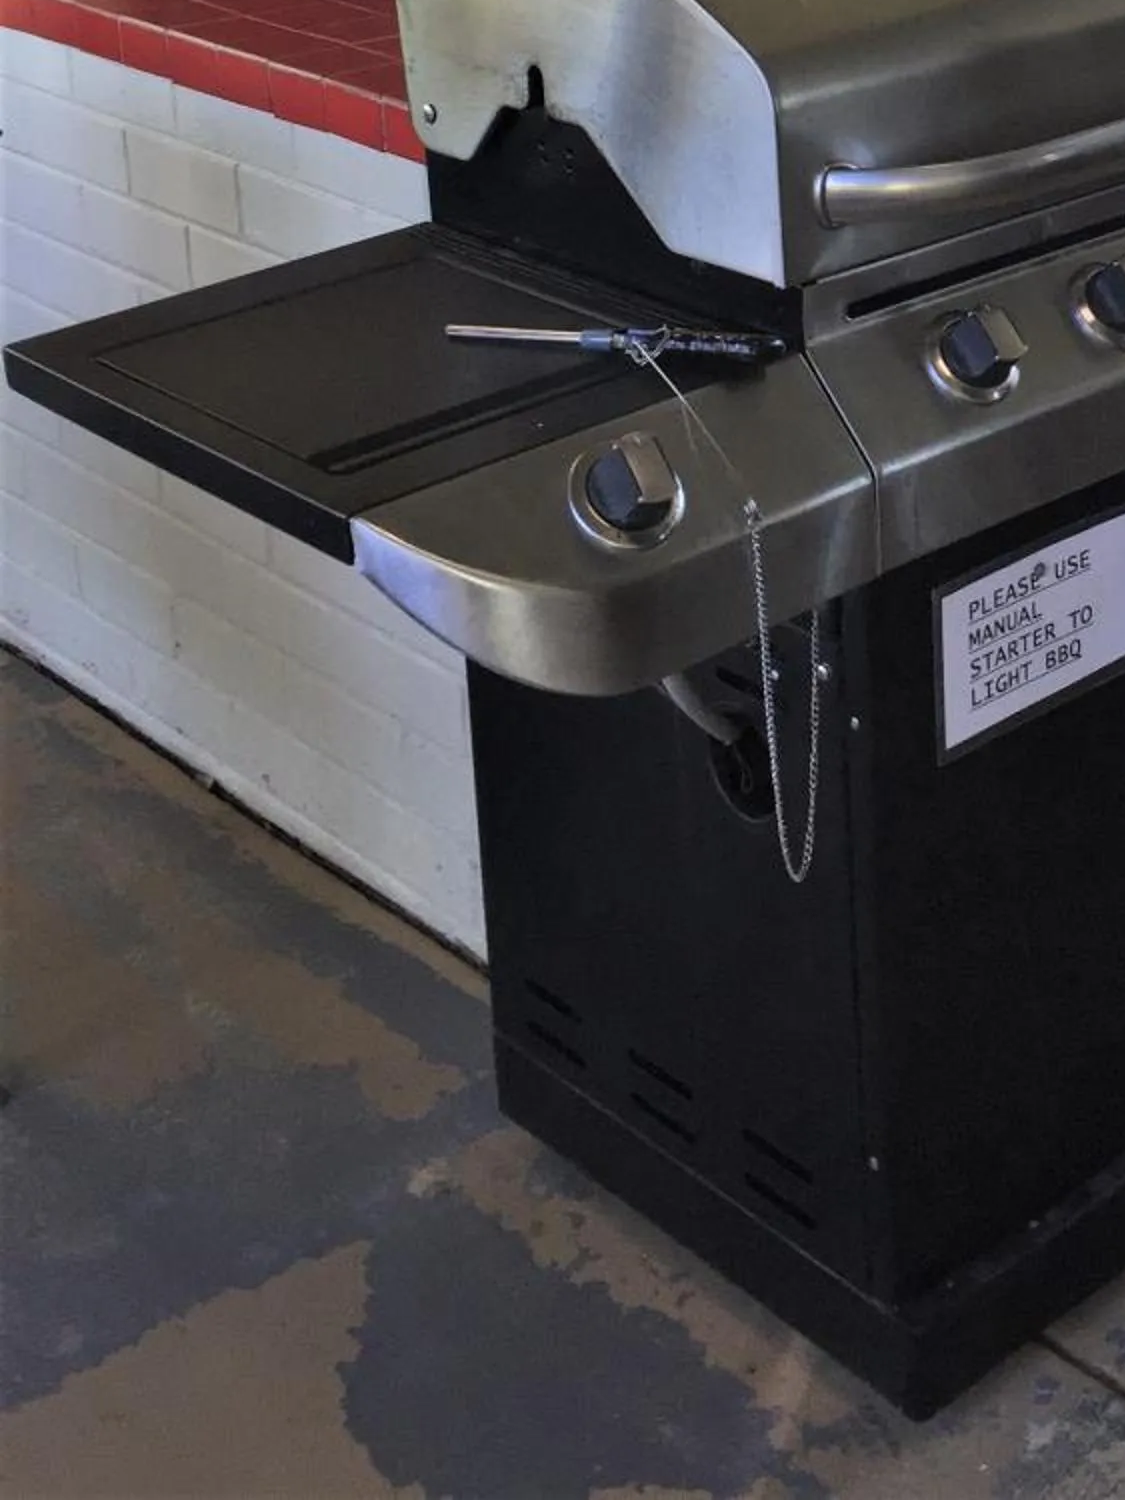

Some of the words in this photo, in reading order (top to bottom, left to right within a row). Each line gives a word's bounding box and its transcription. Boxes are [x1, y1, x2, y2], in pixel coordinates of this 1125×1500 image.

[968, 571, 1042, 621] PLEASE
[1054, 549, 1092, 580] USE
[968, 601, 1043, 650] MANUAL
[970, 622, 1057, 680] STARTER
[1067, 604, 1094, 630] TO
[970, 661, 1034, 707] LIGHT
[1044, 638, 1082, 669] BBQ
